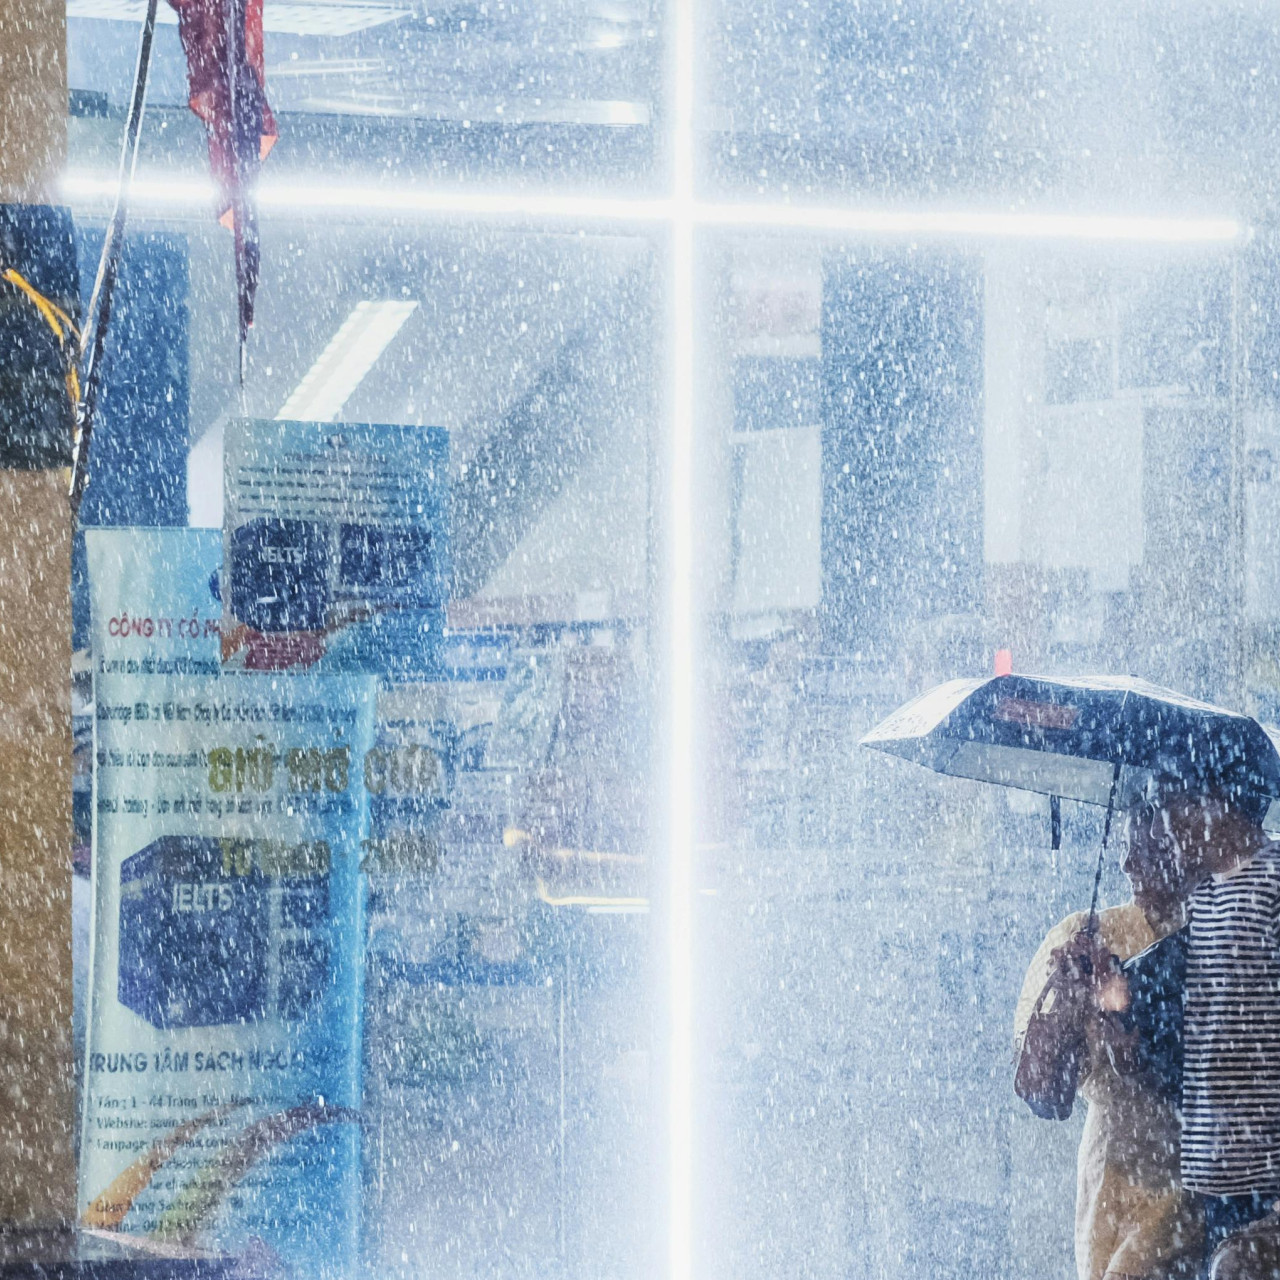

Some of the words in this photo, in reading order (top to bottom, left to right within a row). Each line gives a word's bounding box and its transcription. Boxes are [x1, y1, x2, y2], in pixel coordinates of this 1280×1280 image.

[261, 546, 304, 564] IELTS
[108, 613, 154, 638] CÔNG
[171, 883, 236, 912] IELTS
[154, 1047, 189, 1073] TÂM
[195, 1047, 243, 1073] SÁCH
[96, 1116, 148, 1129] Website:
